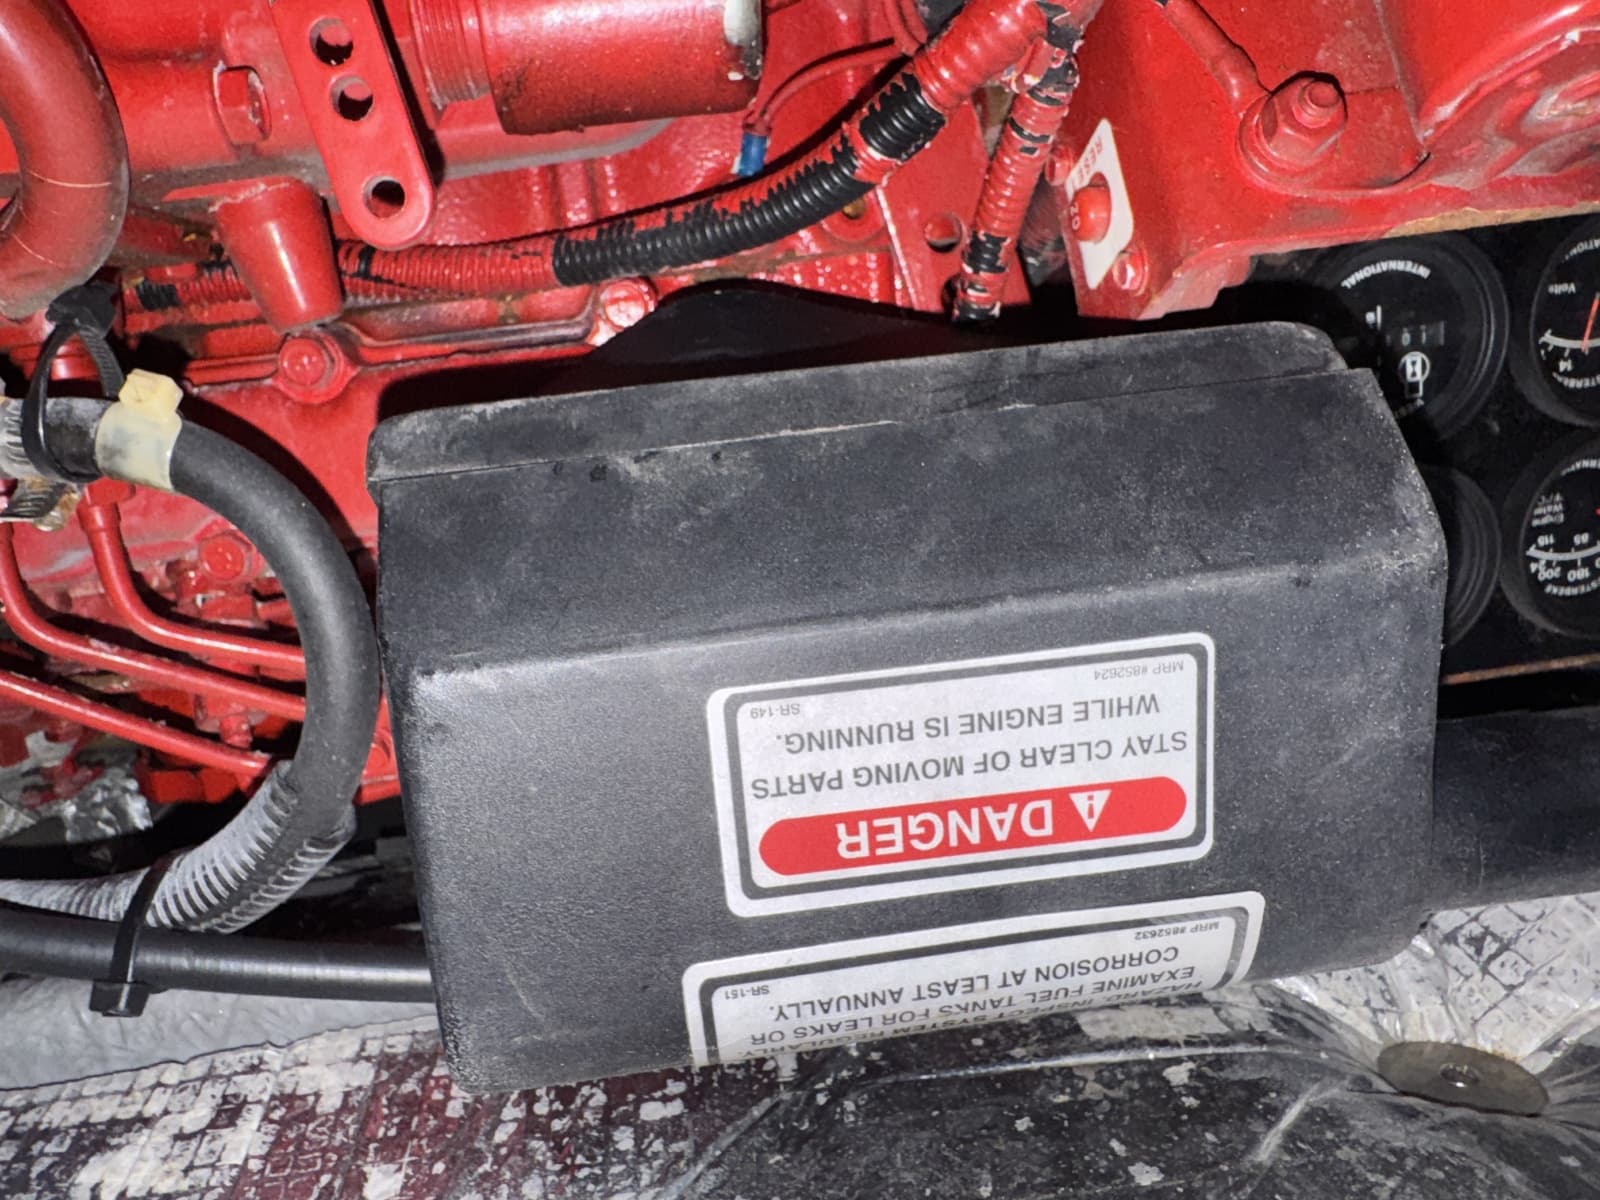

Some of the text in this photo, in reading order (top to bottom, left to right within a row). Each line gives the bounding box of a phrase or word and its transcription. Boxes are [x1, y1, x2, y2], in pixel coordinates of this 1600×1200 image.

[1340, 260, 1431, 290] INTERNATIONAL
[1559, 359, 1573, 373] 14
[1567, 567, 1590, 582] 180
[1094, 660, 1184, 680] MRP #852624
[750, 703, 801, 719] SR-149
[776, 693, 1159, 754] WHILE ENGINE IS RUNNING.
[751, 731, 1187, 799] STAY CLEAR OF MOVING PARTS
[835, 799, 1053, 859] DANGER
[1134, 920, 1219, 940] MRP #852632
[724, 985, 770, 1000] SR-151
[770, 946, 1179, 1022] CORROSION AT LEAST ANNUALLY.
[751, 966, 1195, 1045] EXAMINE FUEL TANKS FOR LEAKS OR
[893, 1015, 987, 1034] SYSTEM
